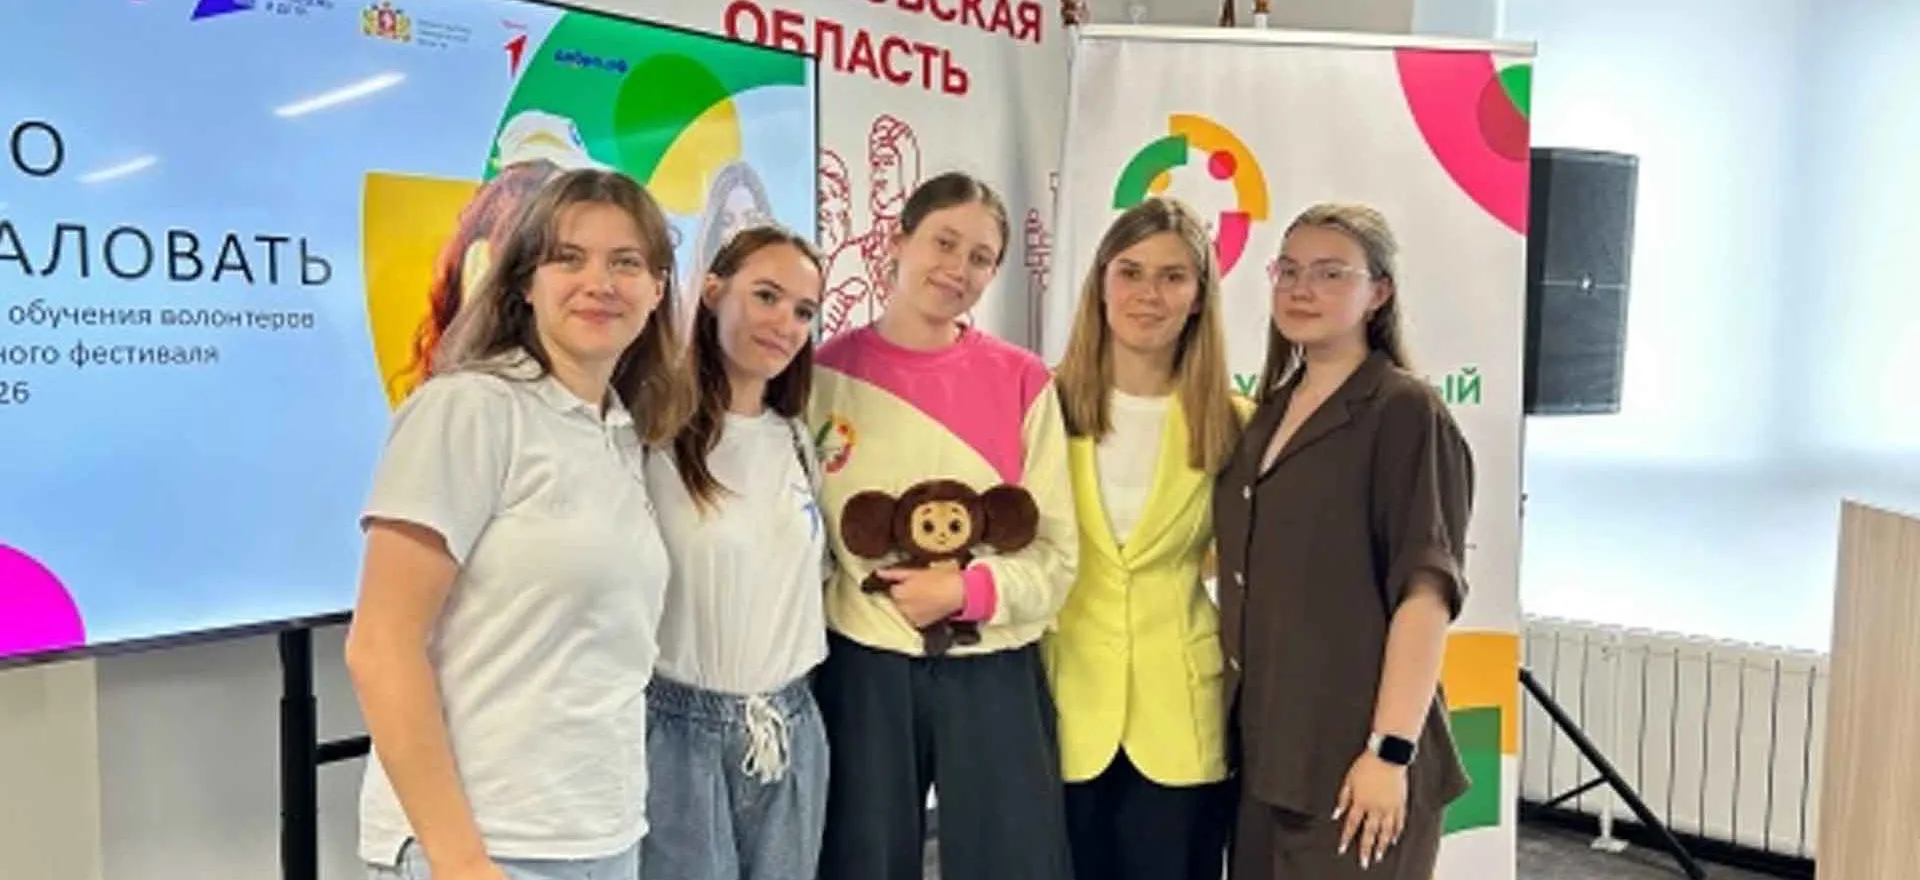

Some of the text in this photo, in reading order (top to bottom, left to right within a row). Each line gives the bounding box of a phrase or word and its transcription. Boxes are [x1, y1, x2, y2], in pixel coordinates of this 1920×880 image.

[723, 0, 969, 95] ОБЛАСТЬ
[8, 299, 316, 331] обучения волонтеров
[69, 338, 220, 368] фестиваля
